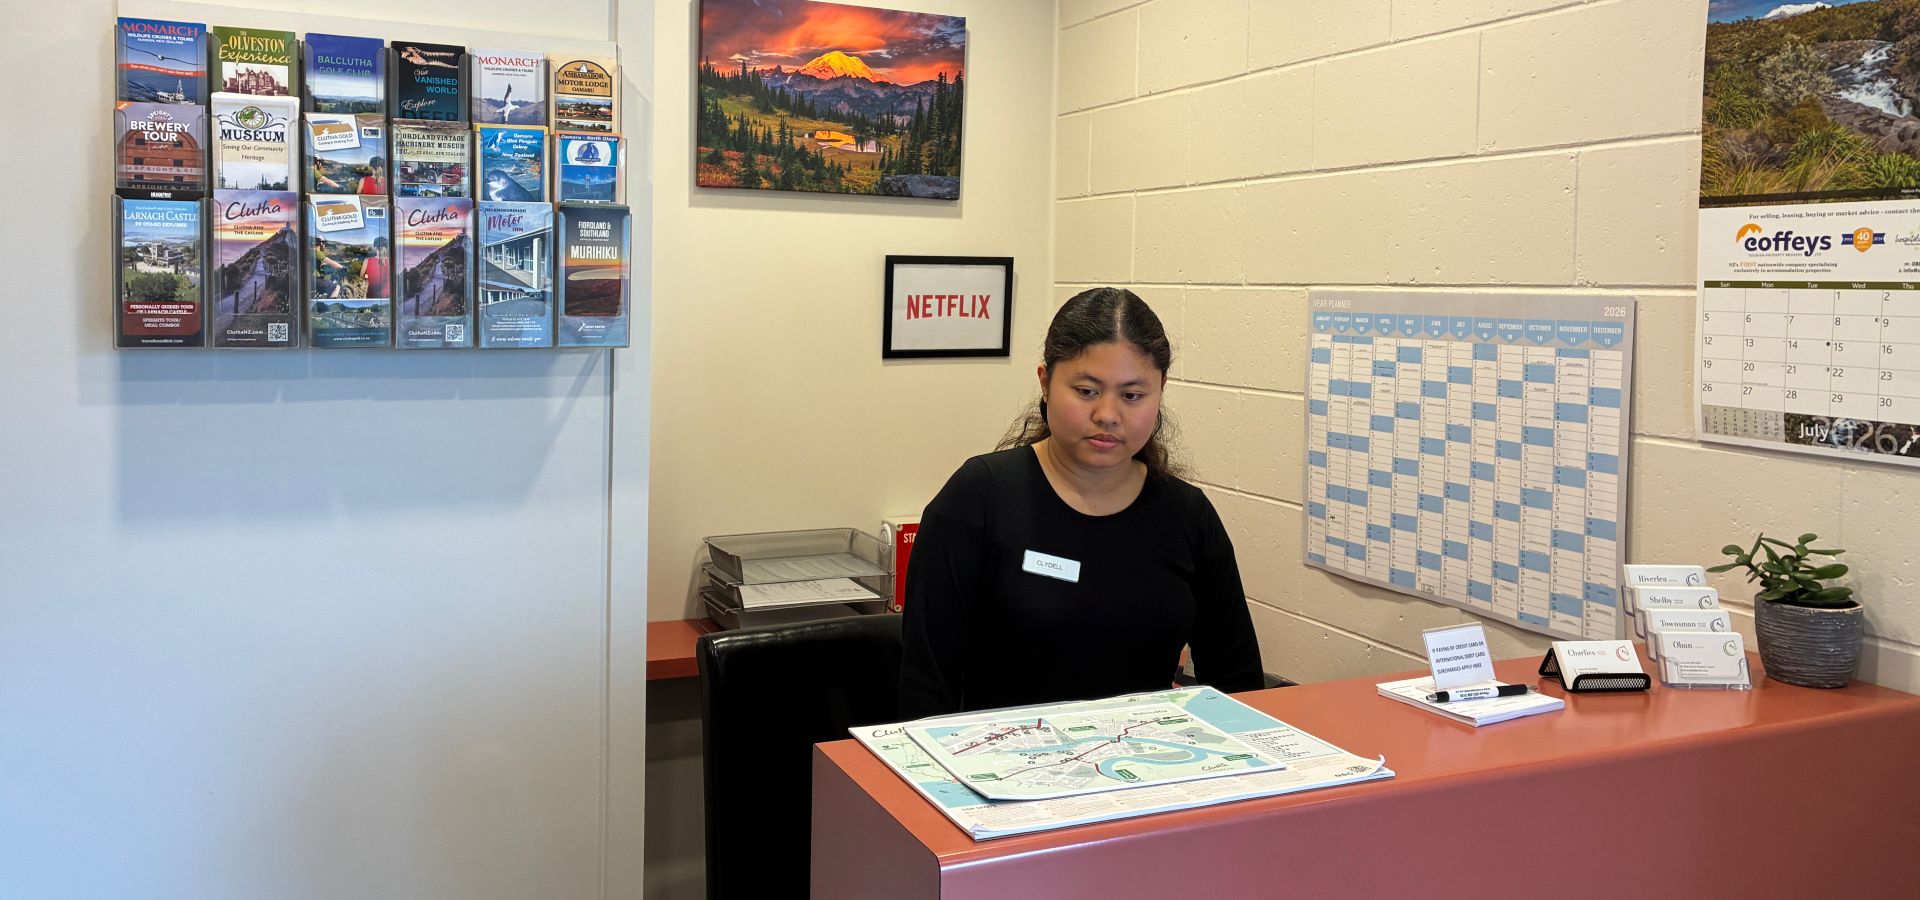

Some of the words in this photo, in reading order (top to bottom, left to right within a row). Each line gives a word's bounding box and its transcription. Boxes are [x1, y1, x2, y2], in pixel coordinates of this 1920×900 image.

[123, 22, 198, 36] MONARCH
[229, 36, 284, 52] OLVESTON
[218, 44, 291, 65] Experience
[318, 56, 372, 67] BALCLUTHA
[478, 57, 539, 67] MONARCH
[320, 66, 343, 75] GOLF
[347, 68, 371, 77] CLUB
[562, 71, 604, 79] AMBASSADOR
[415, 76, 458, 86] VANISHED
[426, 86, 458, 94] WORLD
[401, 99, 436, 112] Explore
[148, 110, 173, 120] SPEIGHT'S
[131, 121, 190, 132] BREWERY
[143, 131, 177, 142] TOUR
[220, 129, 285, 143] MUSEUM
[124, 210, 164, 220] LARNACH
[226, 200, 281, 220] Clutha
[408, 208, 457, 226] Clutha
[488, 213, 523, 231] Motor
[578, 221, 606, 230] FIORDLAND
[607, 222, 611, 230] &
[580, 230, 609, 238] SOUTHLAND
[1857, 232, 1869, 240] 40
[1744, 231, 1832, 257] coffeys
[571, 245, 617, 259] MURIHIKU
[1837, 292, 1840, 300] 1
[1884, 292, 1890, 300] 2
[906, 294, 991, 320] NETFLIX
[1314, 299, 1327, 308] YEAR
[1329, 300, 1351, 308] PLANNER
[1604, 306, 1626, 317] 2026
[1789, 316, 1794, 324] 7
[1835, 317, 1840, 325] 8
[1883, 319, 1889, 327] 9
[1704, 337, 1712, 345] 12
[1788, 341, 1797, 349] 14
[1834, 343, 1843, 351] 15
[1882, 345, 1892, 354] 16
[1704, 360, 1711, 368] 19
[1744, 363, 1754, 371] 20
[1787, 366, 1796, 374] 21
[1833, 368, 1843, 377] 22
[1881, 371, 1892, 380] 23
[1702, 384, 1712, 392] 26
[1743, 387, 1752, 395] 27
[1786, 390, 1797, 399] 28
[1832, 394, 1842, 403] 29
[1880, 398, 1891, 407] 30
[1799, 423, 1830, 441] July
[1811, 416, 1898, 454] 2026
[1036, 559, 1063, 571] CLYDELL
[1650, 597, 1672, 605] Shelby
[1436, 655, 1464, 663] INTERNATIONAL
[1437, 666, 1461, 674] SURCHARGES
